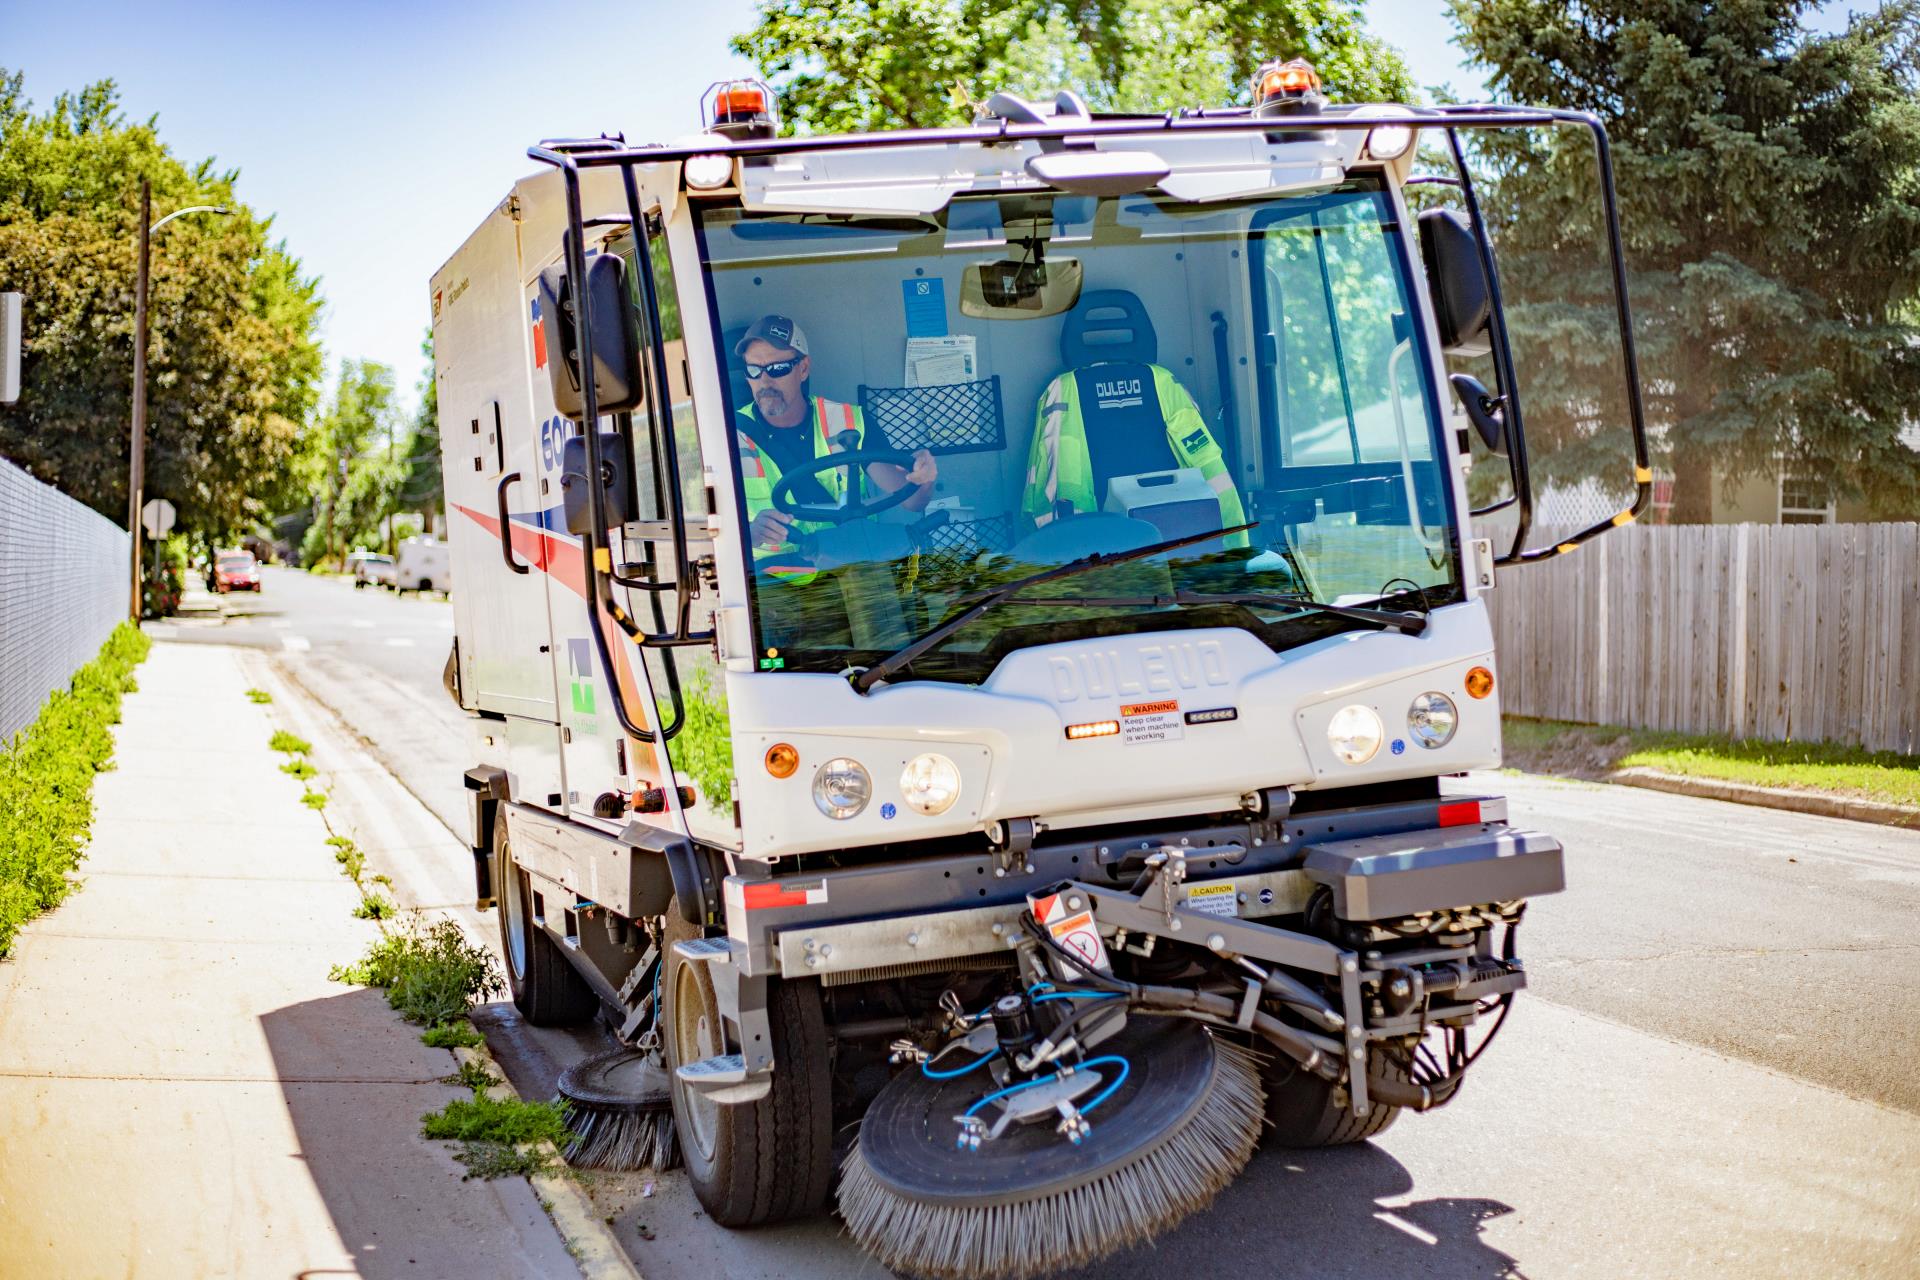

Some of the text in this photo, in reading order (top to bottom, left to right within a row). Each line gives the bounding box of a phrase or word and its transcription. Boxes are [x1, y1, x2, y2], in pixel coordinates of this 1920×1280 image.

[1095, 379, 1141, 397] DULEVO
[1048, 640, 1229, 703] DULEVO
[1133, 702, 1176, 713] WARNING
[1125, 714, 1164, 725] Keep clear
[1126, 721, 1179, 733] when machine
[1135, 731, 1165, 740] working
[1200, 885, 1232, 895] CAUTION
